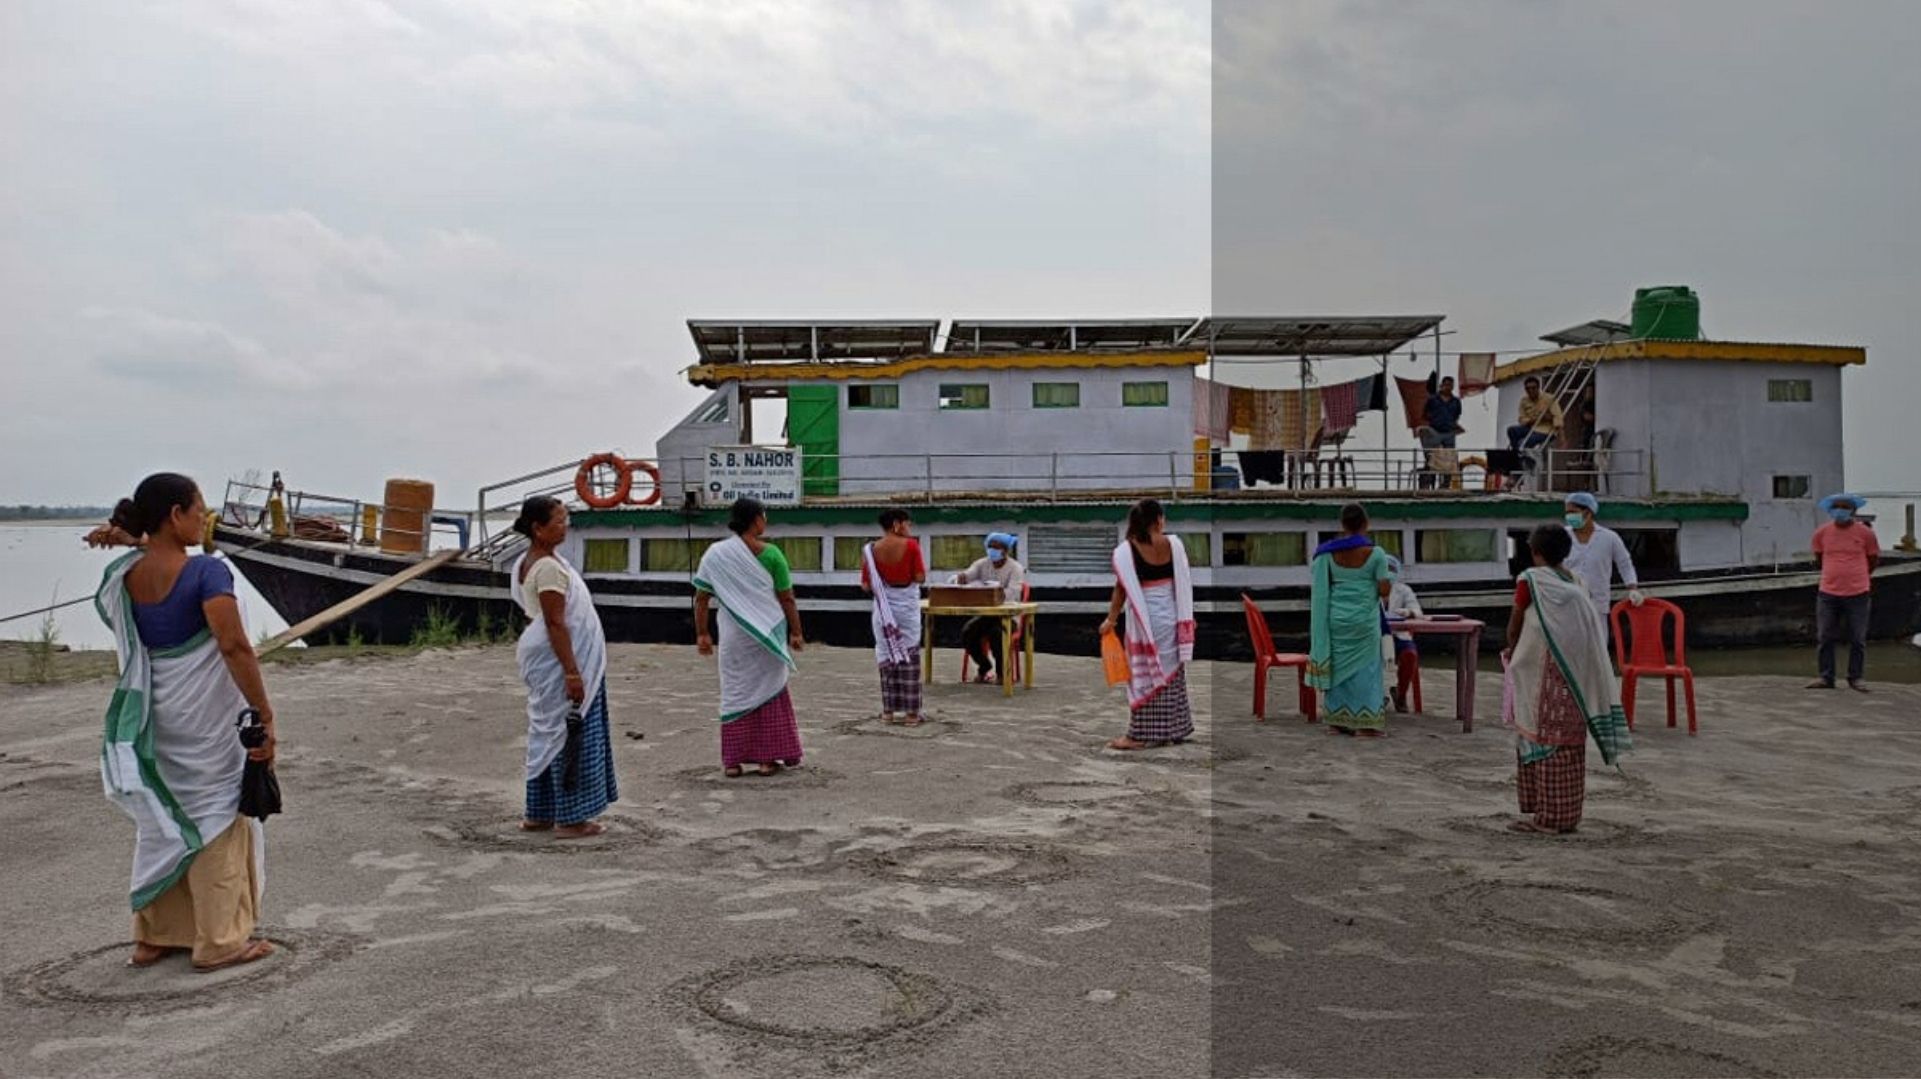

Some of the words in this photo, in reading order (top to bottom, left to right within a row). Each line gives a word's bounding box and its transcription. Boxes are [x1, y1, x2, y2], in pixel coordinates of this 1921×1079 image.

[709, 453, 722, 467] S.
[726, 453, 741, 467] B.
[744, 453, 794, 467] NAHOR
[723, 490, 735, 500] Oil
[762, 489, 794, 500] Limited
